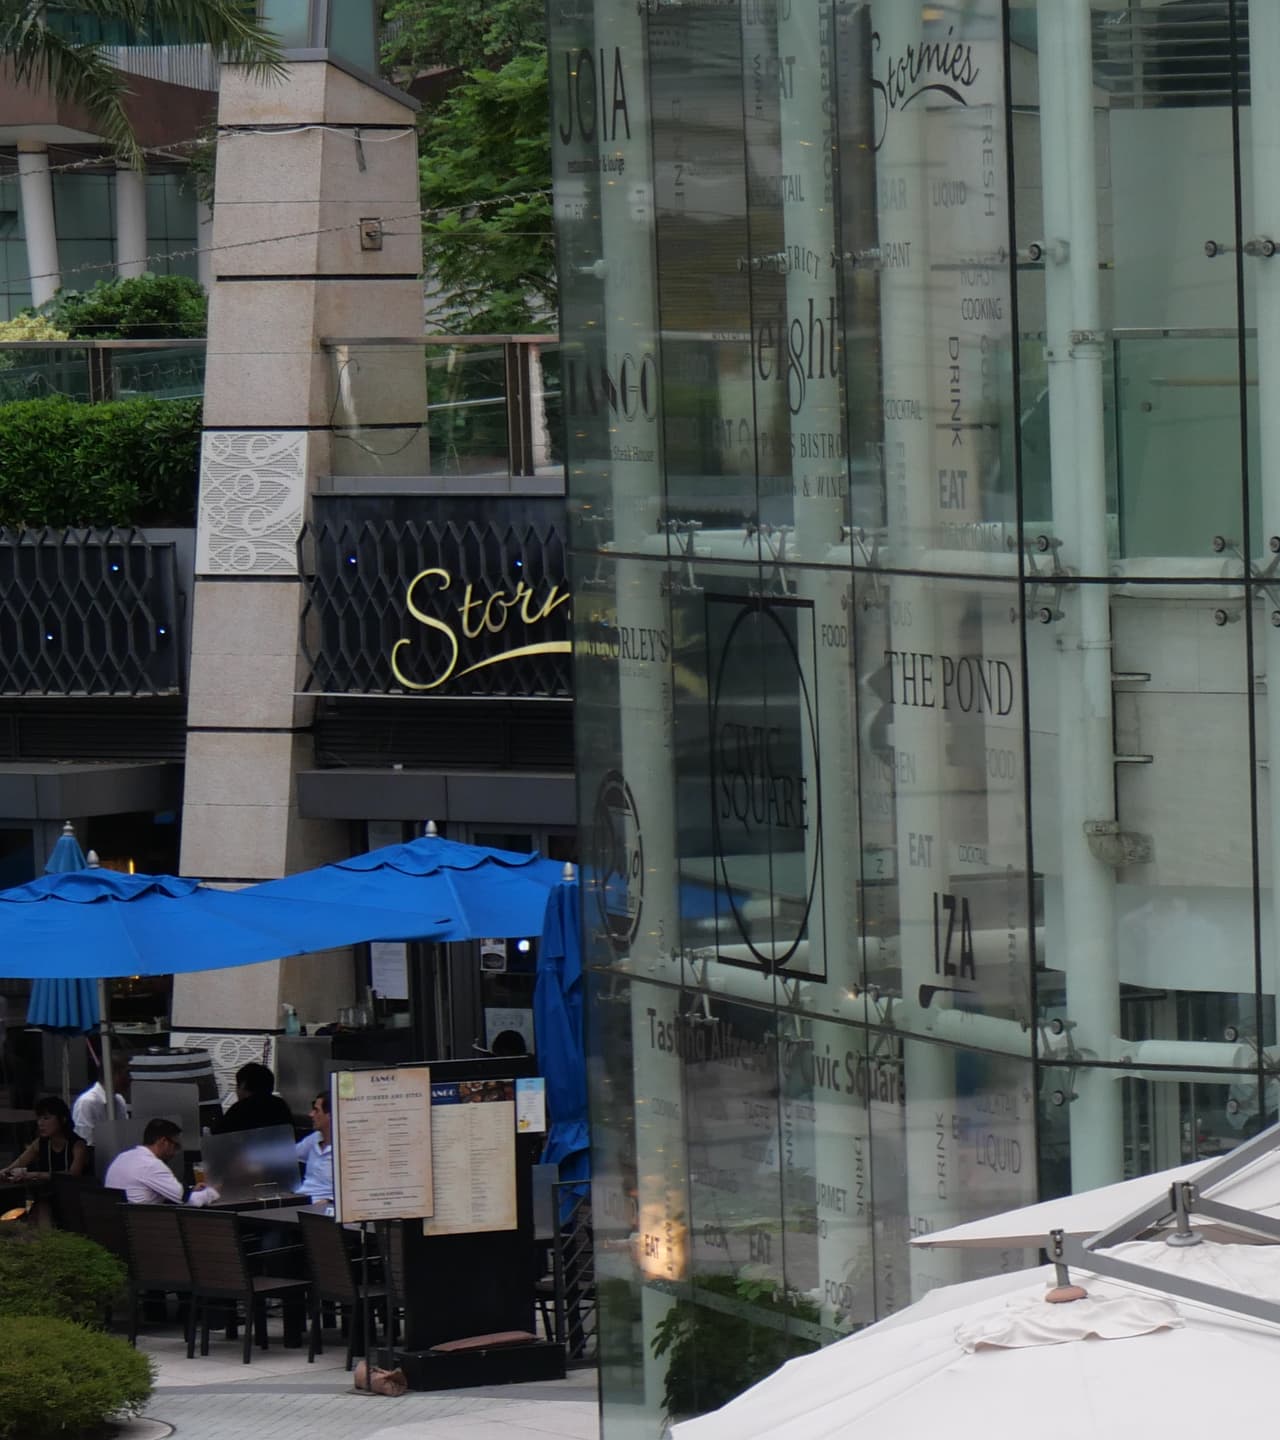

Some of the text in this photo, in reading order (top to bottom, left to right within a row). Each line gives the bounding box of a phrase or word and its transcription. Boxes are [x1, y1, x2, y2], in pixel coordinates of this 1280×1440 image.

[559, 46, 631, 146] JOIA
[868, 25, 980, 152] Stormies
[932, 178, 967, 208] LIQUID
[982, 103, 997, 217] FRESH
[961, 297, 1003, 321] COOKING
[563, 351, 659, 423] TANGO
[756, 296, 840, 416] eight
[884, 399, 924, 422] COCKTAIL
[948, 335, 963, 448] DRINK
[800, 432, 845, 459] BISTRO
[802, 474, 812, 498] &
[816, 475, 849, 499] WINE
[938, 470, 968, 511] EAT
[821, 623, 849, 649] FOOD
[883, 650, 1014, 717] THE POND
[719, 721, 782, 774] CIVIC
[720, 770, 810, 836] SQUARE
[908, 832, 934, 868] EAT
[933, 890, 977, 981] IZA
[647, 1007, 706, 1064] Tasting
[845, 1050, 906, 1108] Square
[432, 1088, 457, 1098] ANGO
[853, 1135, 866, 1217] DRINK
[936, 1112, 948, 1200] DRINK
[975, 1127, 1021, 1175] LIQUID
